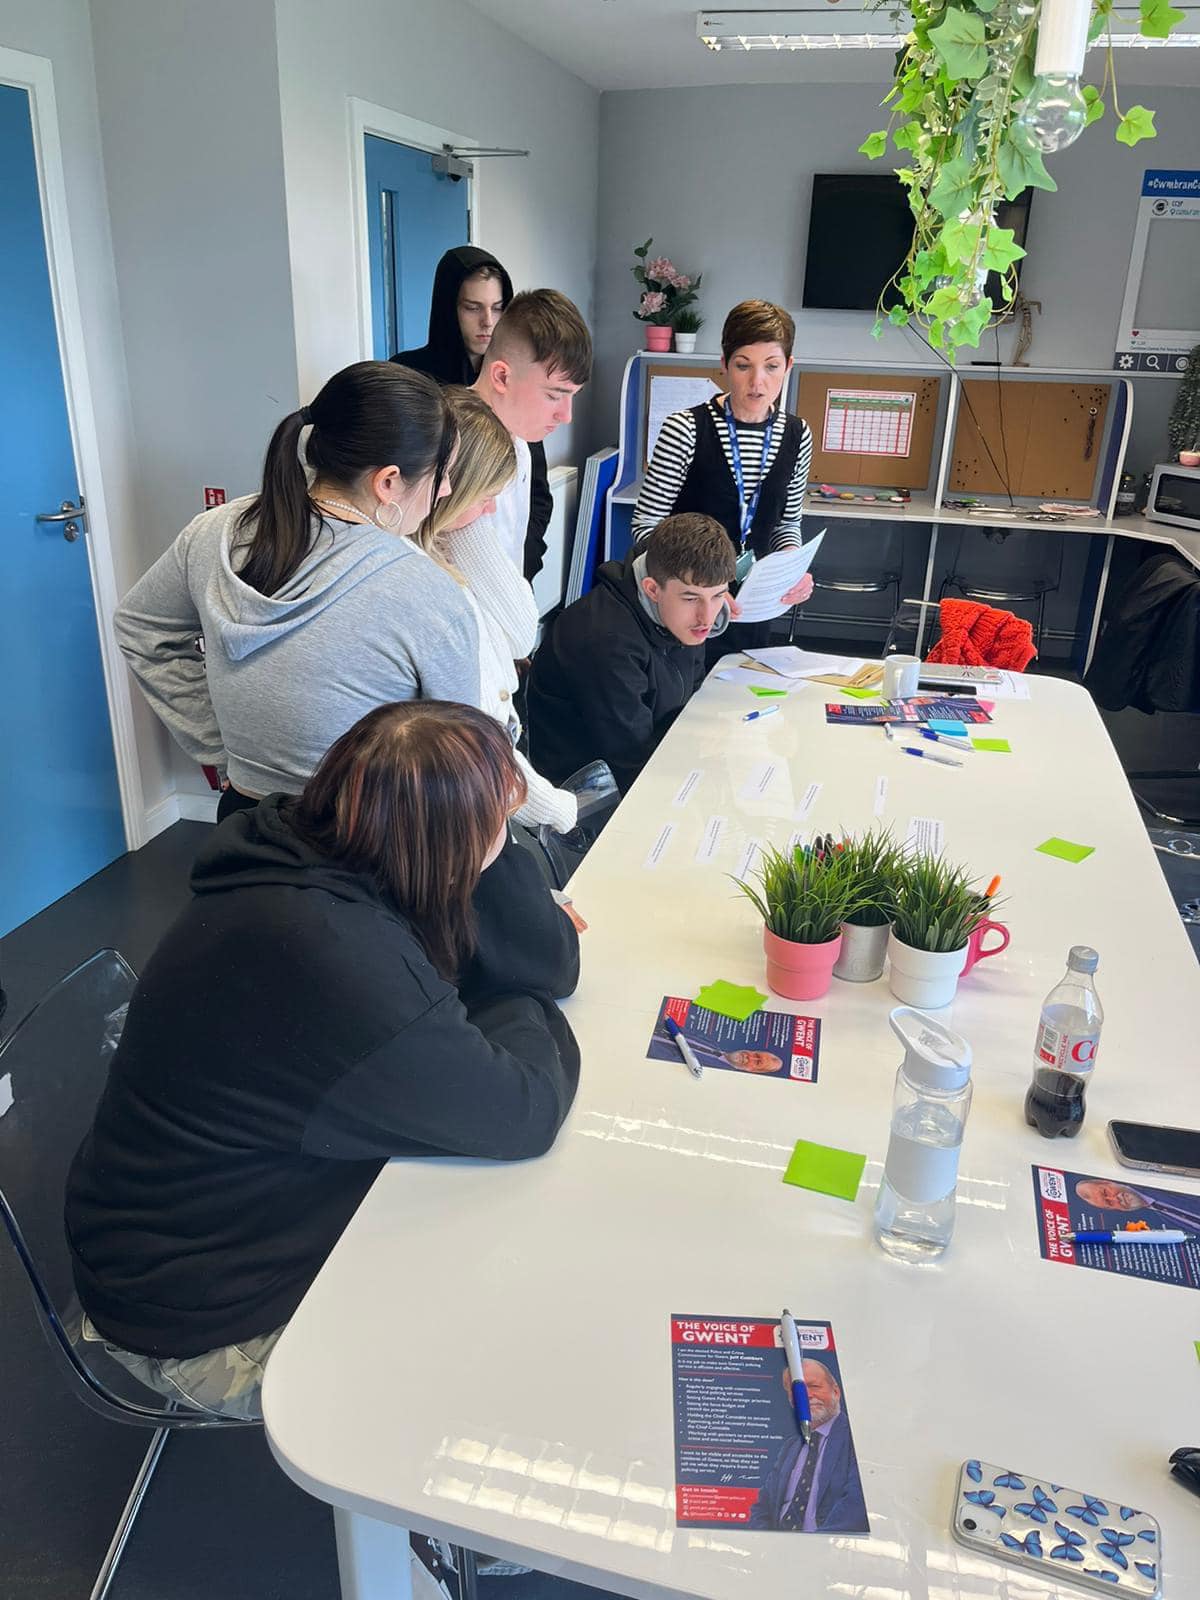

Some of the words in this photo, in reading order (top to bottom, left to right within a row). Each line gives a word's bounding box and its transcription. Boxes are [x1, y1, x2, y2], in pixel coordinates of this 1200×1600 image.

[1045, 1208, 1054, 1219] OF
[1046, 1219, 1056, 1241] VOICE
[1048, 1242, 1059, 1257] THE
[676, 1321, 700, 1330] THE
[703, 1322, 736, 1332] VOICE
[740, 1324, 755, 1333] OF
[682, 1330, 751, 1345] GWENT
